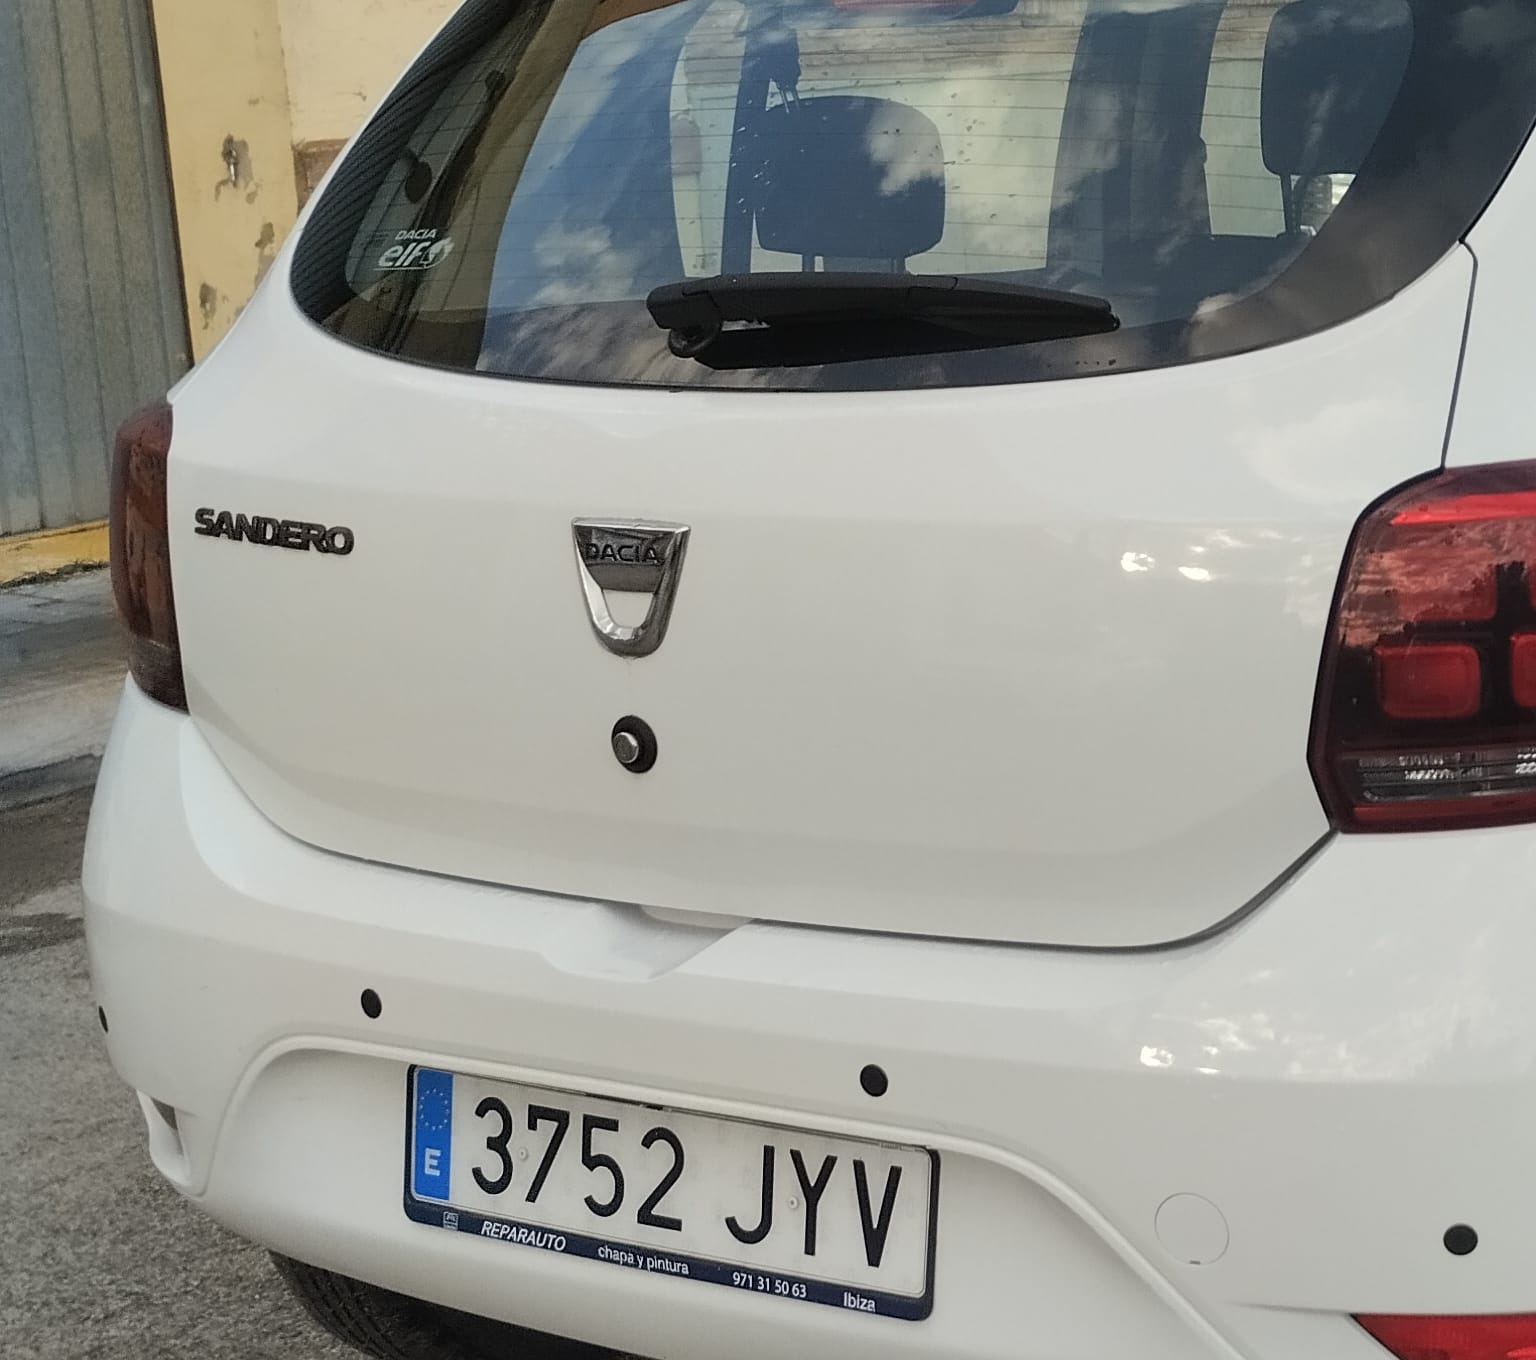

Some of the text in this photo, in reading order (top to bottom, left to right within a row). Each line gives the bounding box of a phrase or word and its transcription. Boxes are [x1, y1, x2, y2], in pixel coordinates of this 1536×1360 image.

[395, 228, 437, 241] DACIA
[377, 240, 433, 268] elf
[194, 507, 355, 555] SANDERO
[585, 543, 658, 562] DACIA
[423, 1147, 441, 1177] E
[471, 1096, 903, 1268] 3752 JYV
[481, 1220, 876, 1313] REPARAUTO chapa y pintura 971 31 50 63 Ibiza
